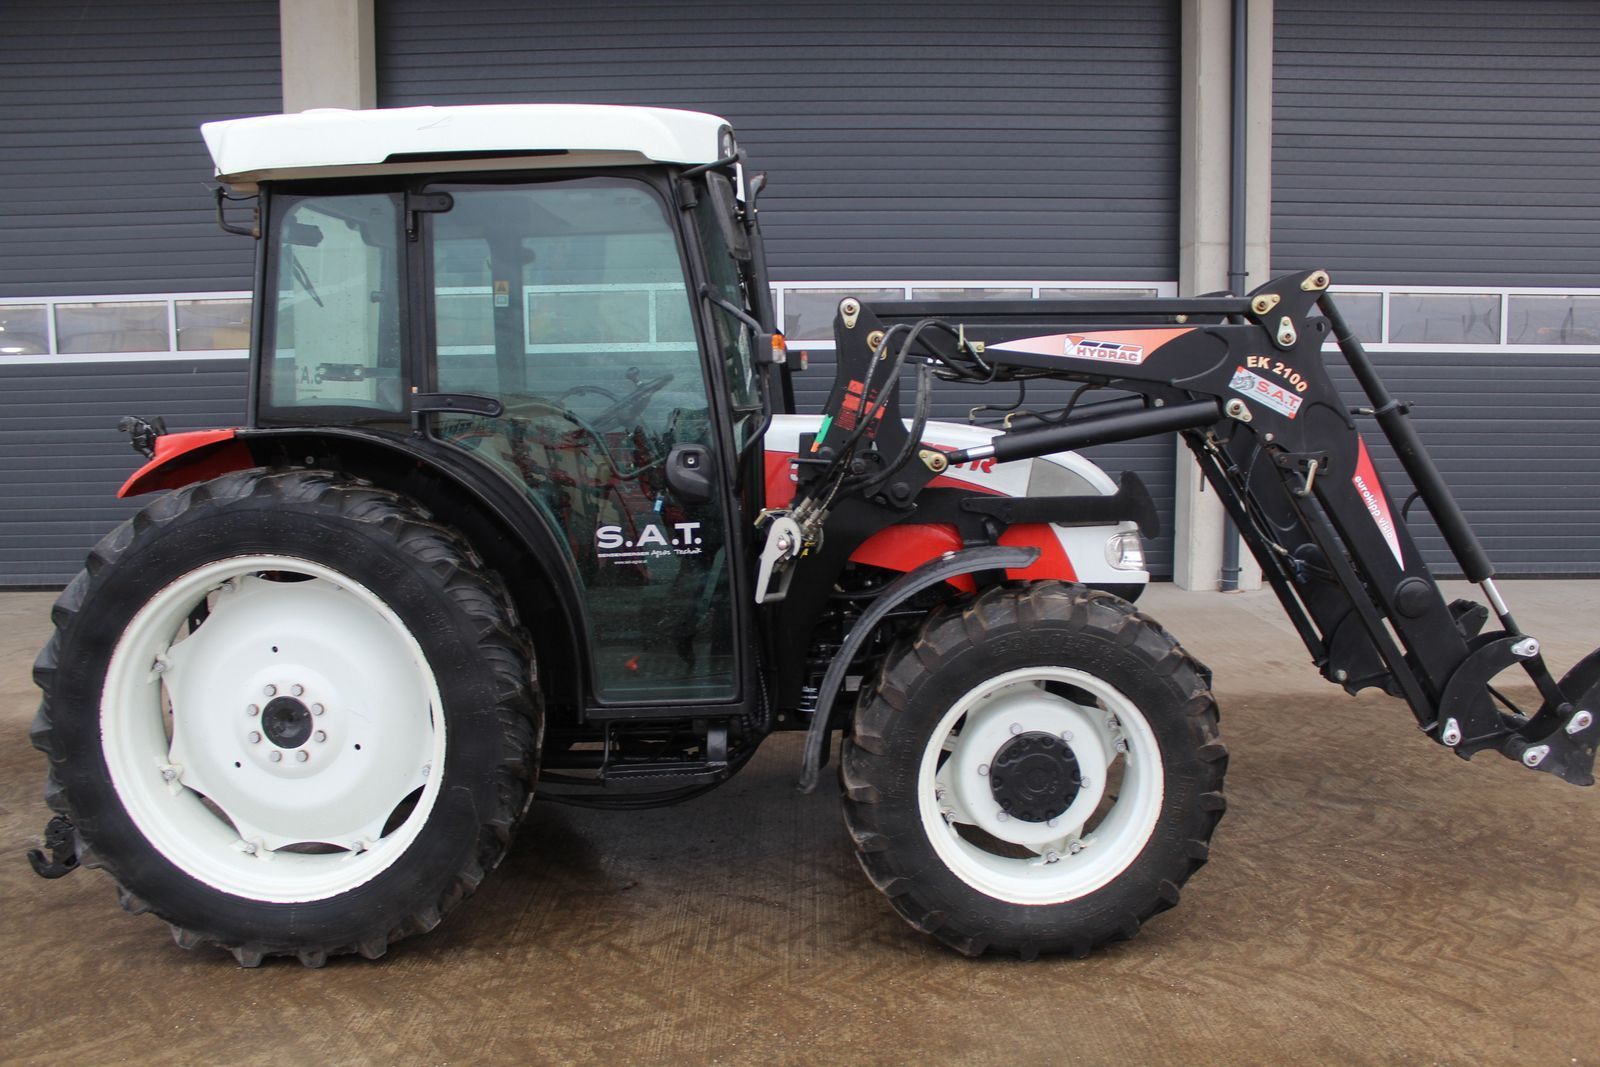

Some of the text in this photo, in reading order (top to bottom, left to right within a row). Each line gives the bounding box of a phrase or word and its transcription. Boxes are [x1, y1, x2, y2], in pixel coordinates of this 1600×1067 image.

[1076, 346, 1138, 362] HYDRAC
[1246, 355, 1308, 392] EK 2100
[1256, 380, 1298, 409] S.A.T.
[1354, 475, 1381, 517] eurokipp
[596, 522, 702, 548] S.A.T.
